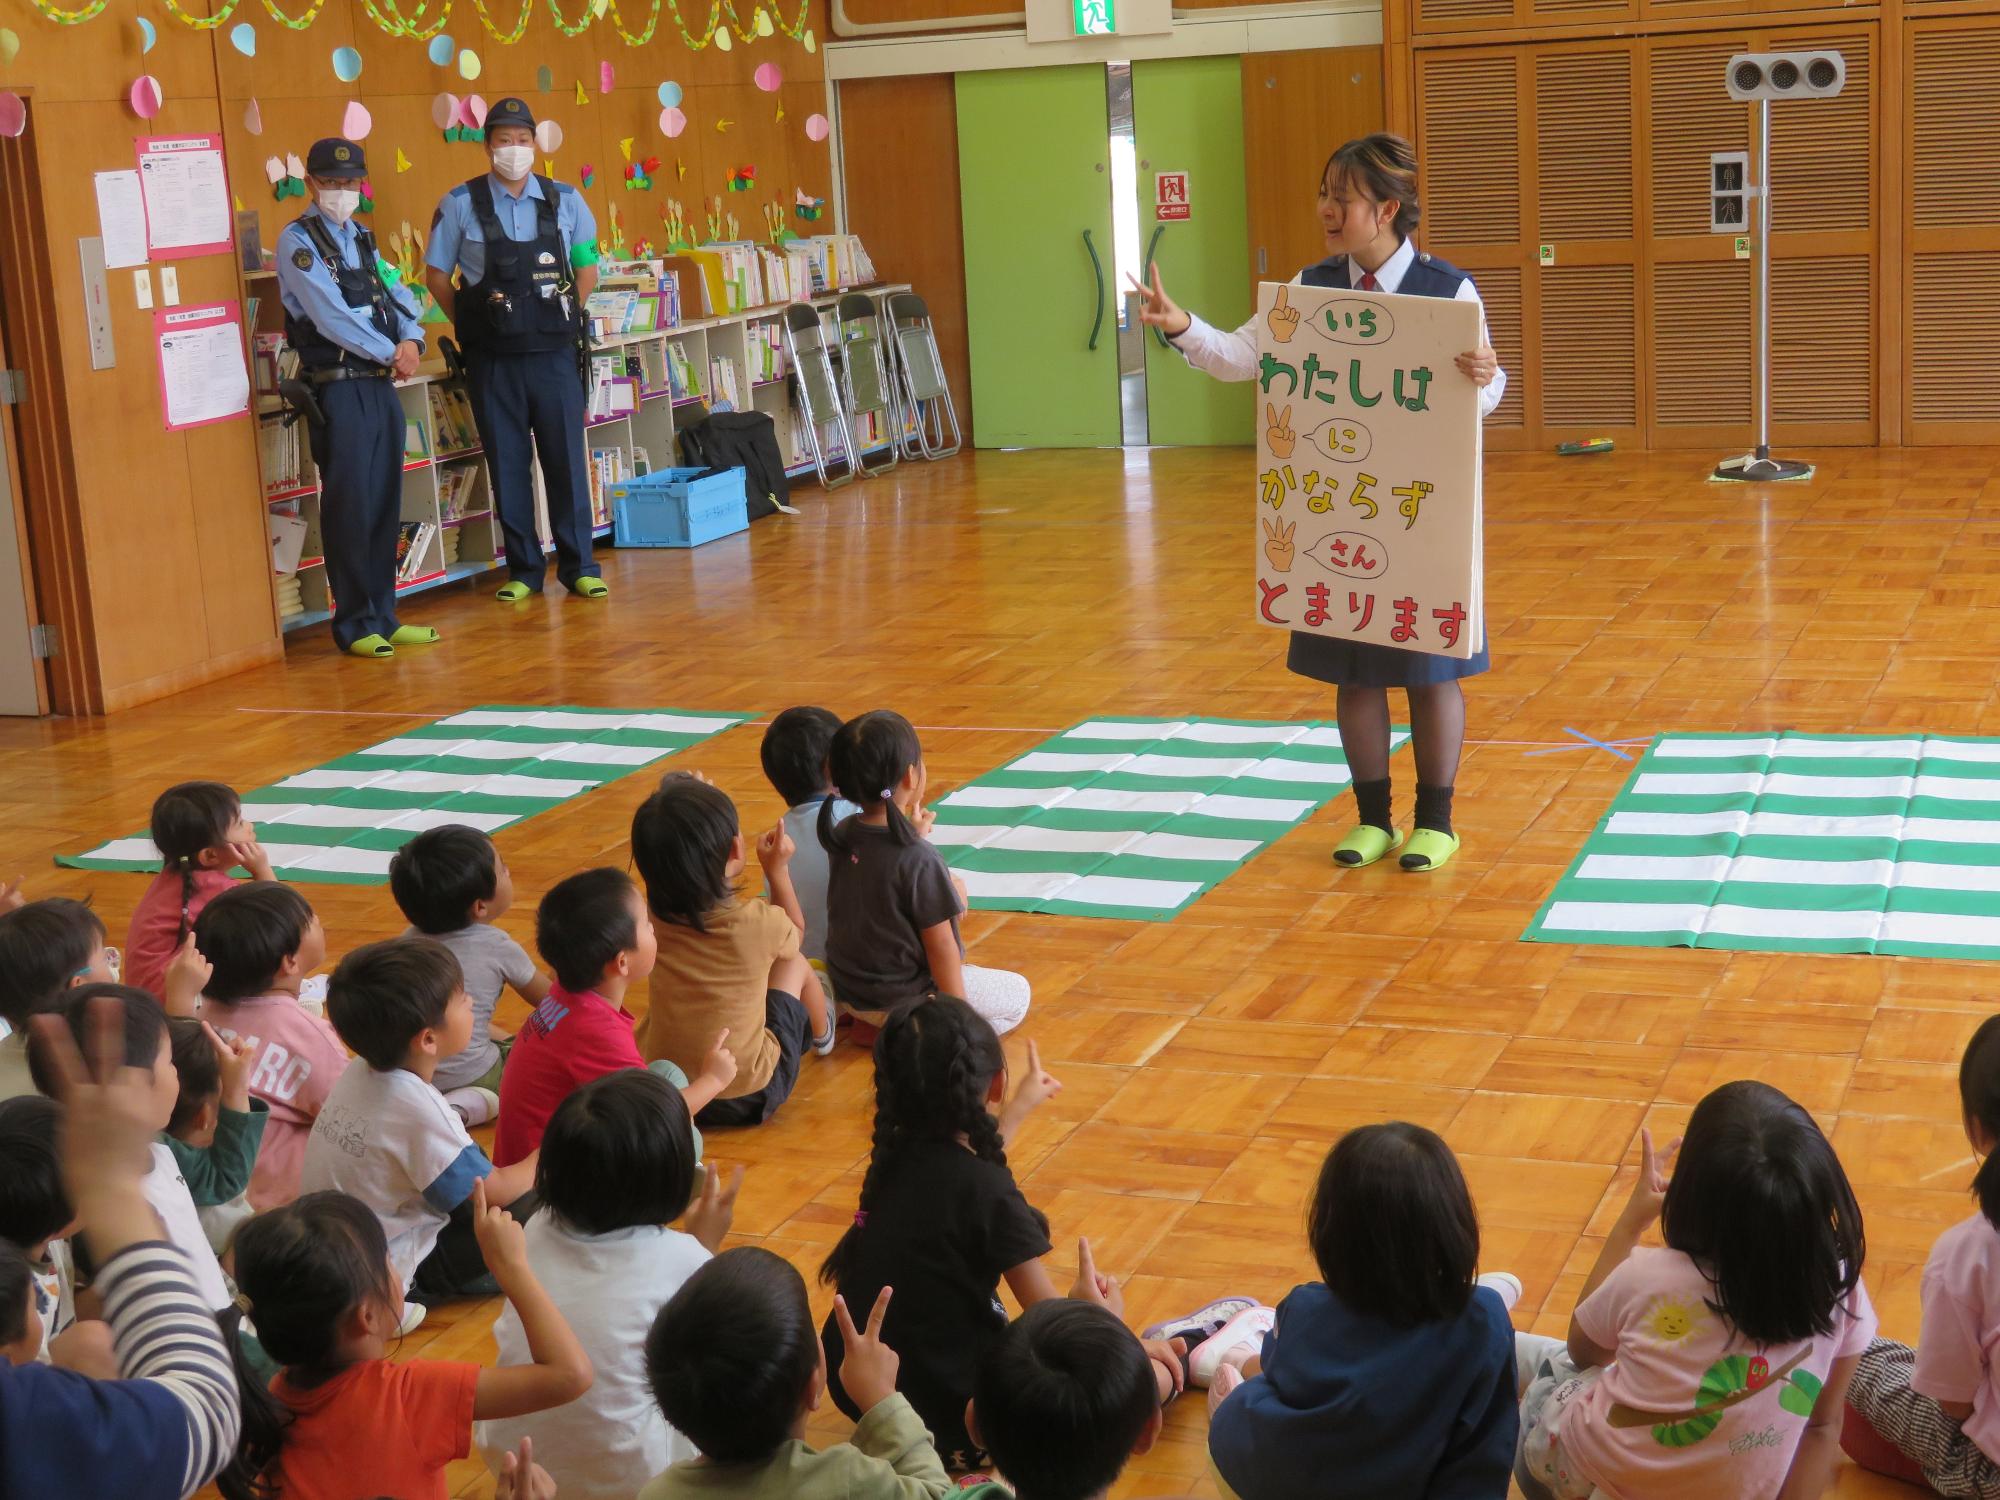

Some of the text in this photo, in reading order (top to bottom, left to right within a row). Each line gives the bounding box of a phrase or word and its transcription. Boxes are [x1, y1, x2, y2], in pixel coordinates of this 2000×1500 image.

[1325, 307, 1377, 338] いち
[1259, 352, 1433, 412] わたしは
[1328, 427, 1356, 453] に
[1259, 465, 1434, 531] かならず
[1330, 538, 1376, 570] さん
[1258, 577, 1467, 649] とまります
